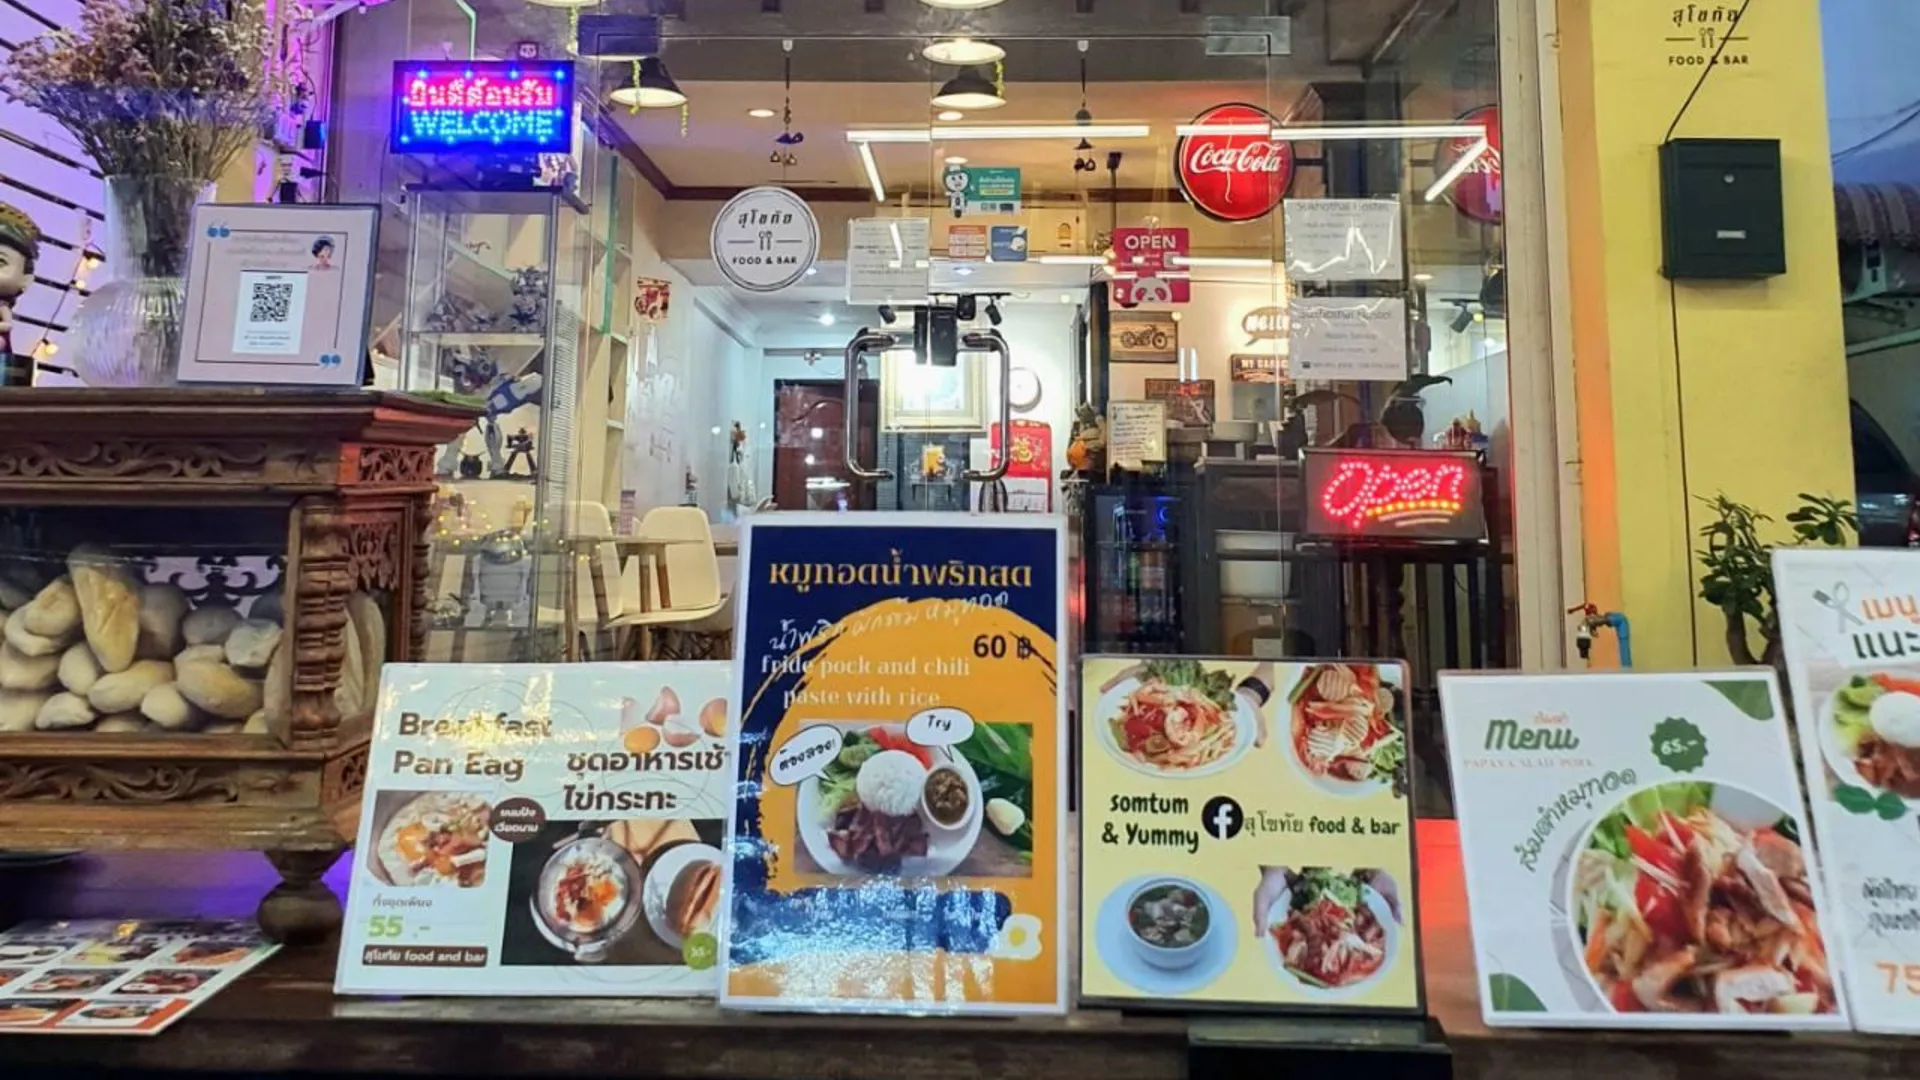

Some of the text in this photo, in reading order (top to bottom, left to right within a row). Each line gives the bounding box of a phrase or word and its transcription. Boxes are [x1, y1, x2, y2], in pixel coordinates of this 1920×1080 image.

[1668, 55, 1704, 65] FOOD
[1723, 55, 1749, 65] BAR
[410, 110, 554, 135] WELCOME
[1190, 141, 1285, 173] Coca-Cola
[1124, 234, 1177, 249] OPEN
[731, 254, 798, 265] FOOD & BAR
[1323, 461, 1464, 528] Open
[769, 549, 1033, 593] หมูทอดน้ำพริกสด
[973, 634, 1007, 658] 60
[877, 656, 917, 675] and
[923, 656, 971, 676] chili
[783, 686, 940, 709] paste with rice
[926, 714, 951, 730] Try
[1484, 719, 1581, 751] Menu
[393, 750, 525, 783] Pan Eag
[563, 782, 677, 811] ไข่กระทะ
[1244, 809, 1401, 837] สุโขทัย food & bar
[1101, 821, 1199, 854] & Yummy
[368, 914, 404, 937] 55
[404, 950, 435, 961] food
[438, 950, 461, 961] and
[464, 950, 484, 962] bar
